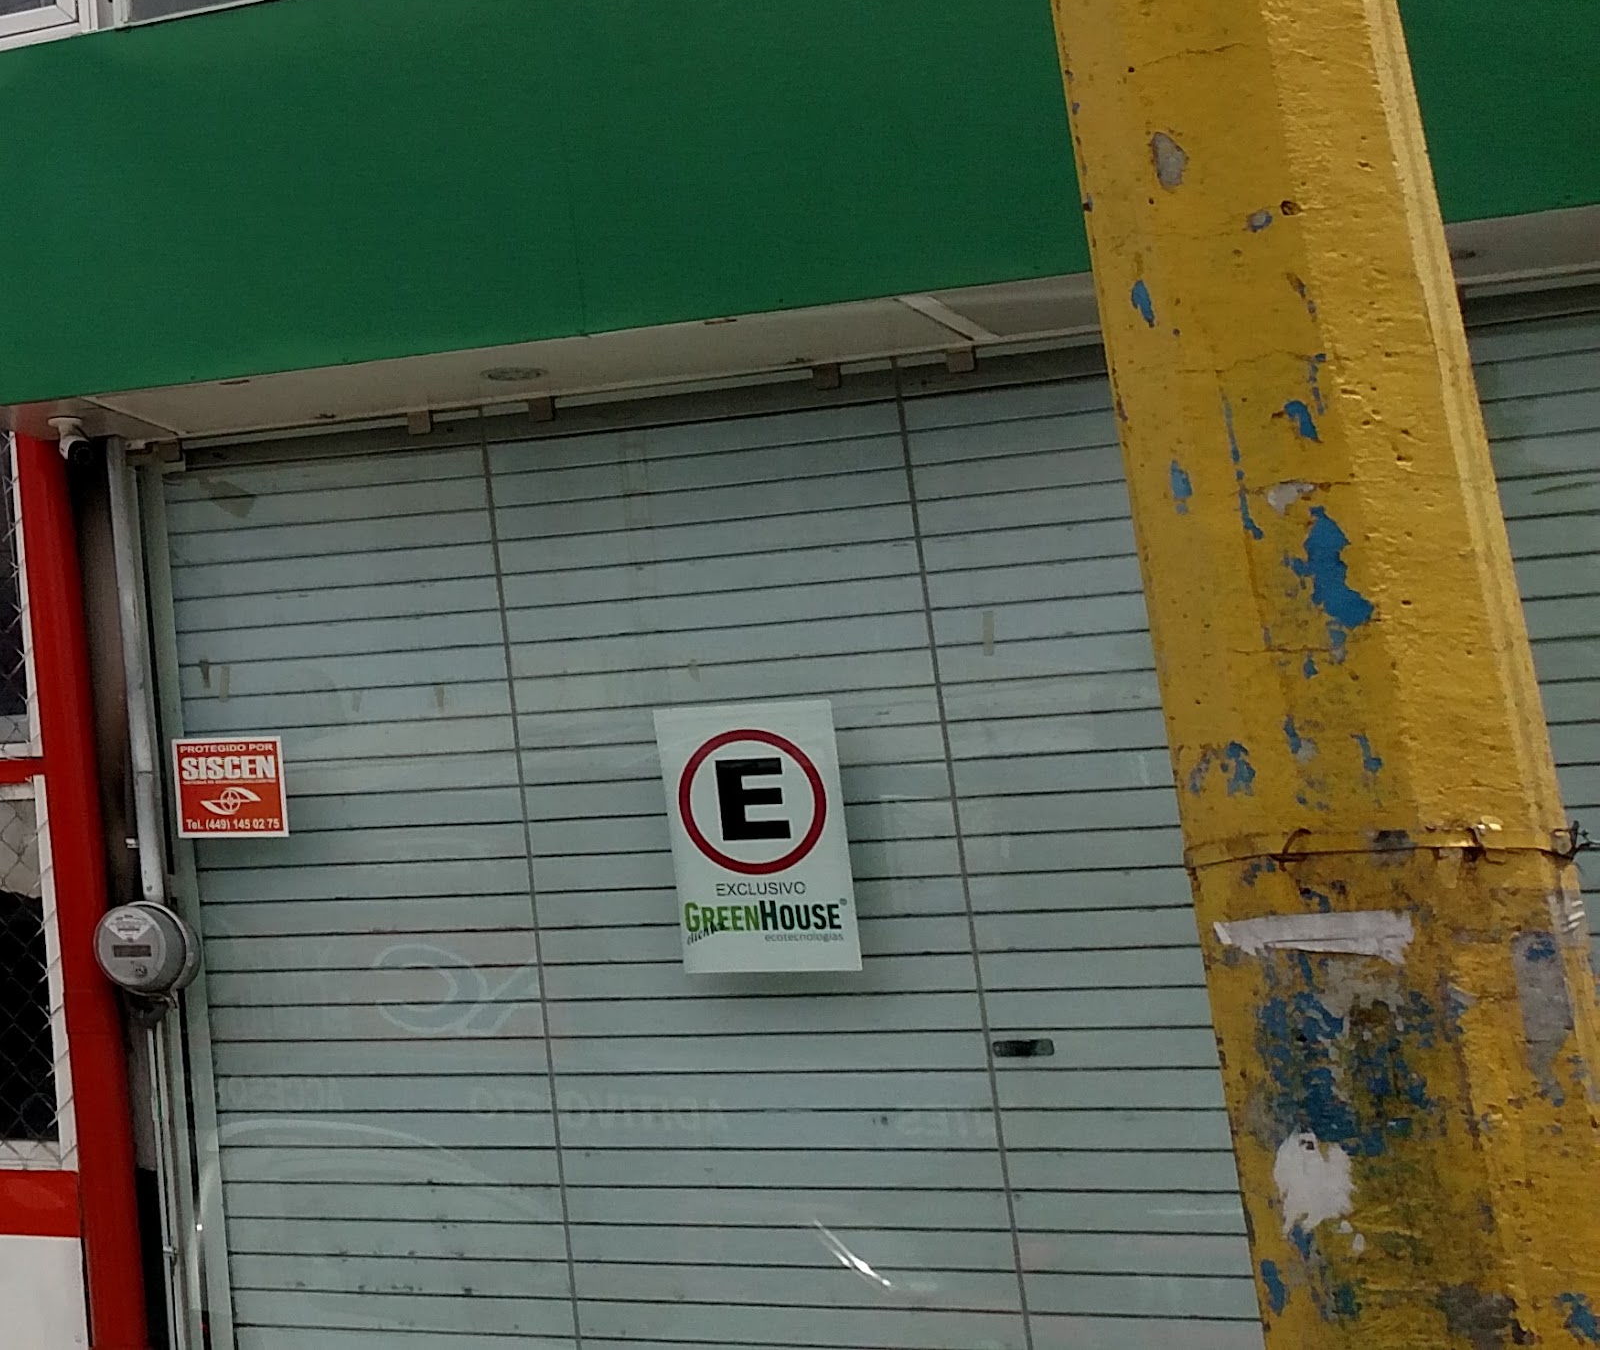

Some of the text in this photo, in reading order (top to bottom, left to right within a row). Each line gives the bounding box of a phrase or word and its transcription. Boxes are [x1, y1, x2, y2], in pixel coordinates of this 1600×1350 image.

[180, 743, 274, 754] PROTEGIDO POR
[181, 754, 277, 781] SISCEN
[714, 757, 792, 841] E
[185, 817, 280, 830] Tel. (449) 145 02 75
[715, 881, 806, 896] EXCLUSIVO
